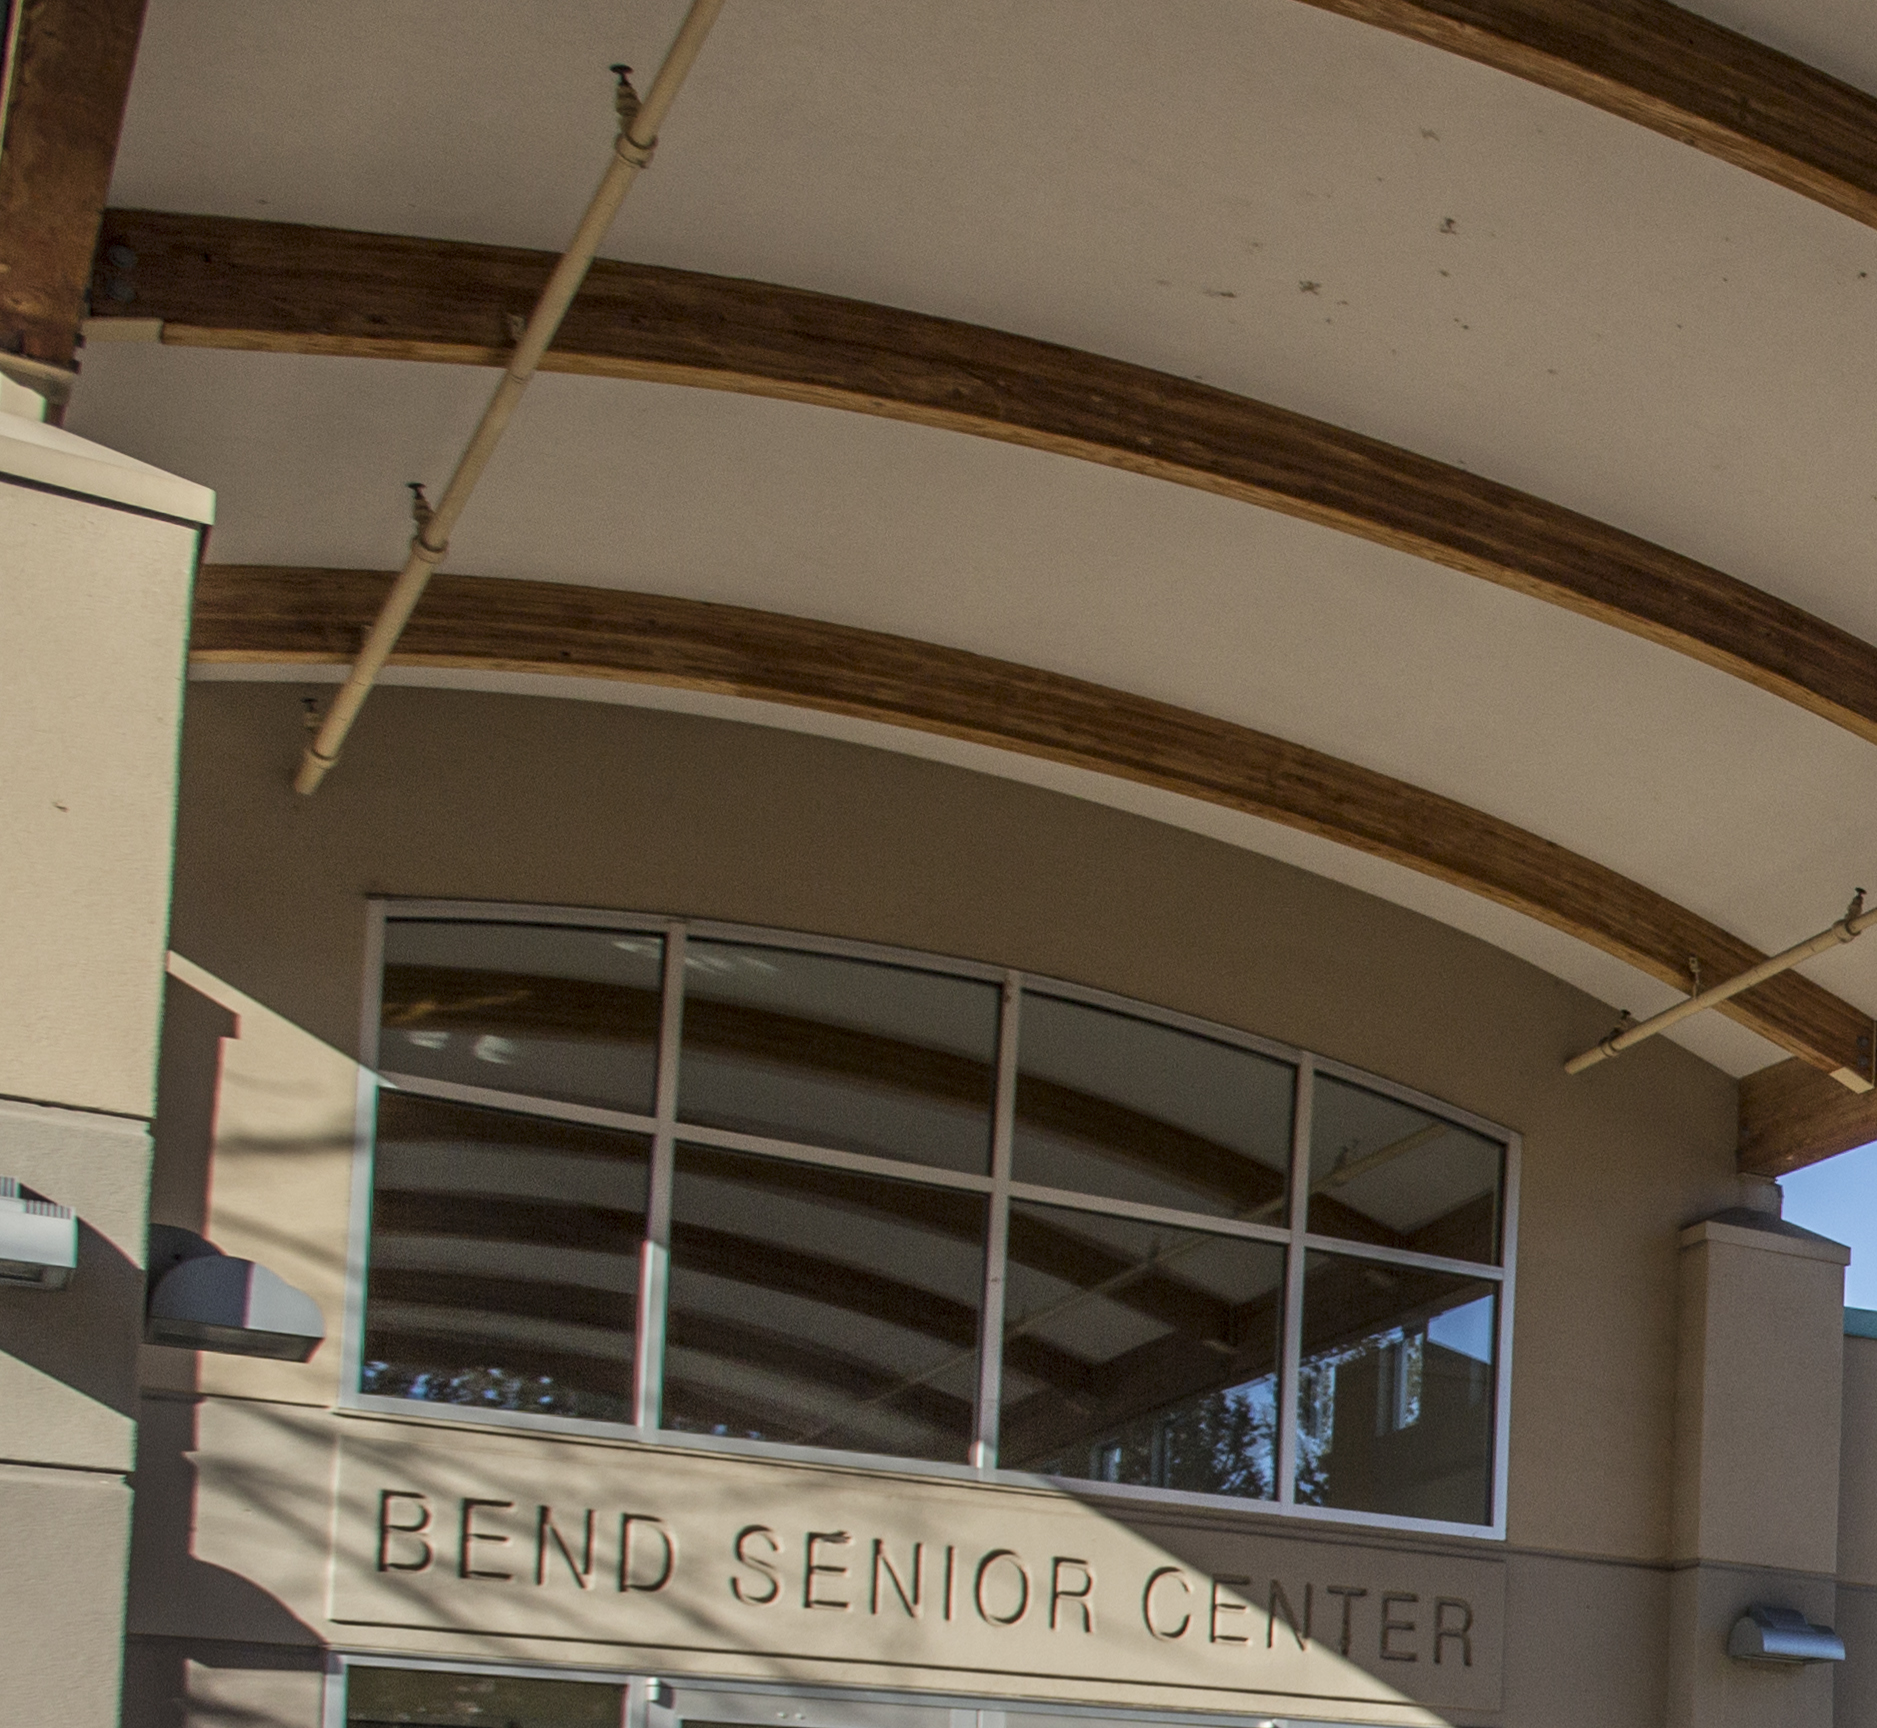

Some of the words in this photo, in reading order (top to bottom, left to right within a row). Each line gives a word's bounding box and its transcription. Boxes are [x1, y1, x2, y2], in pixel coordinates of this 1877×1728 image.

[377, 1488, 679, 1593] BEND
[730, 1523, 1096, 1634] SENIOR
[1141, 1565, 1475, 1667] CENTER
